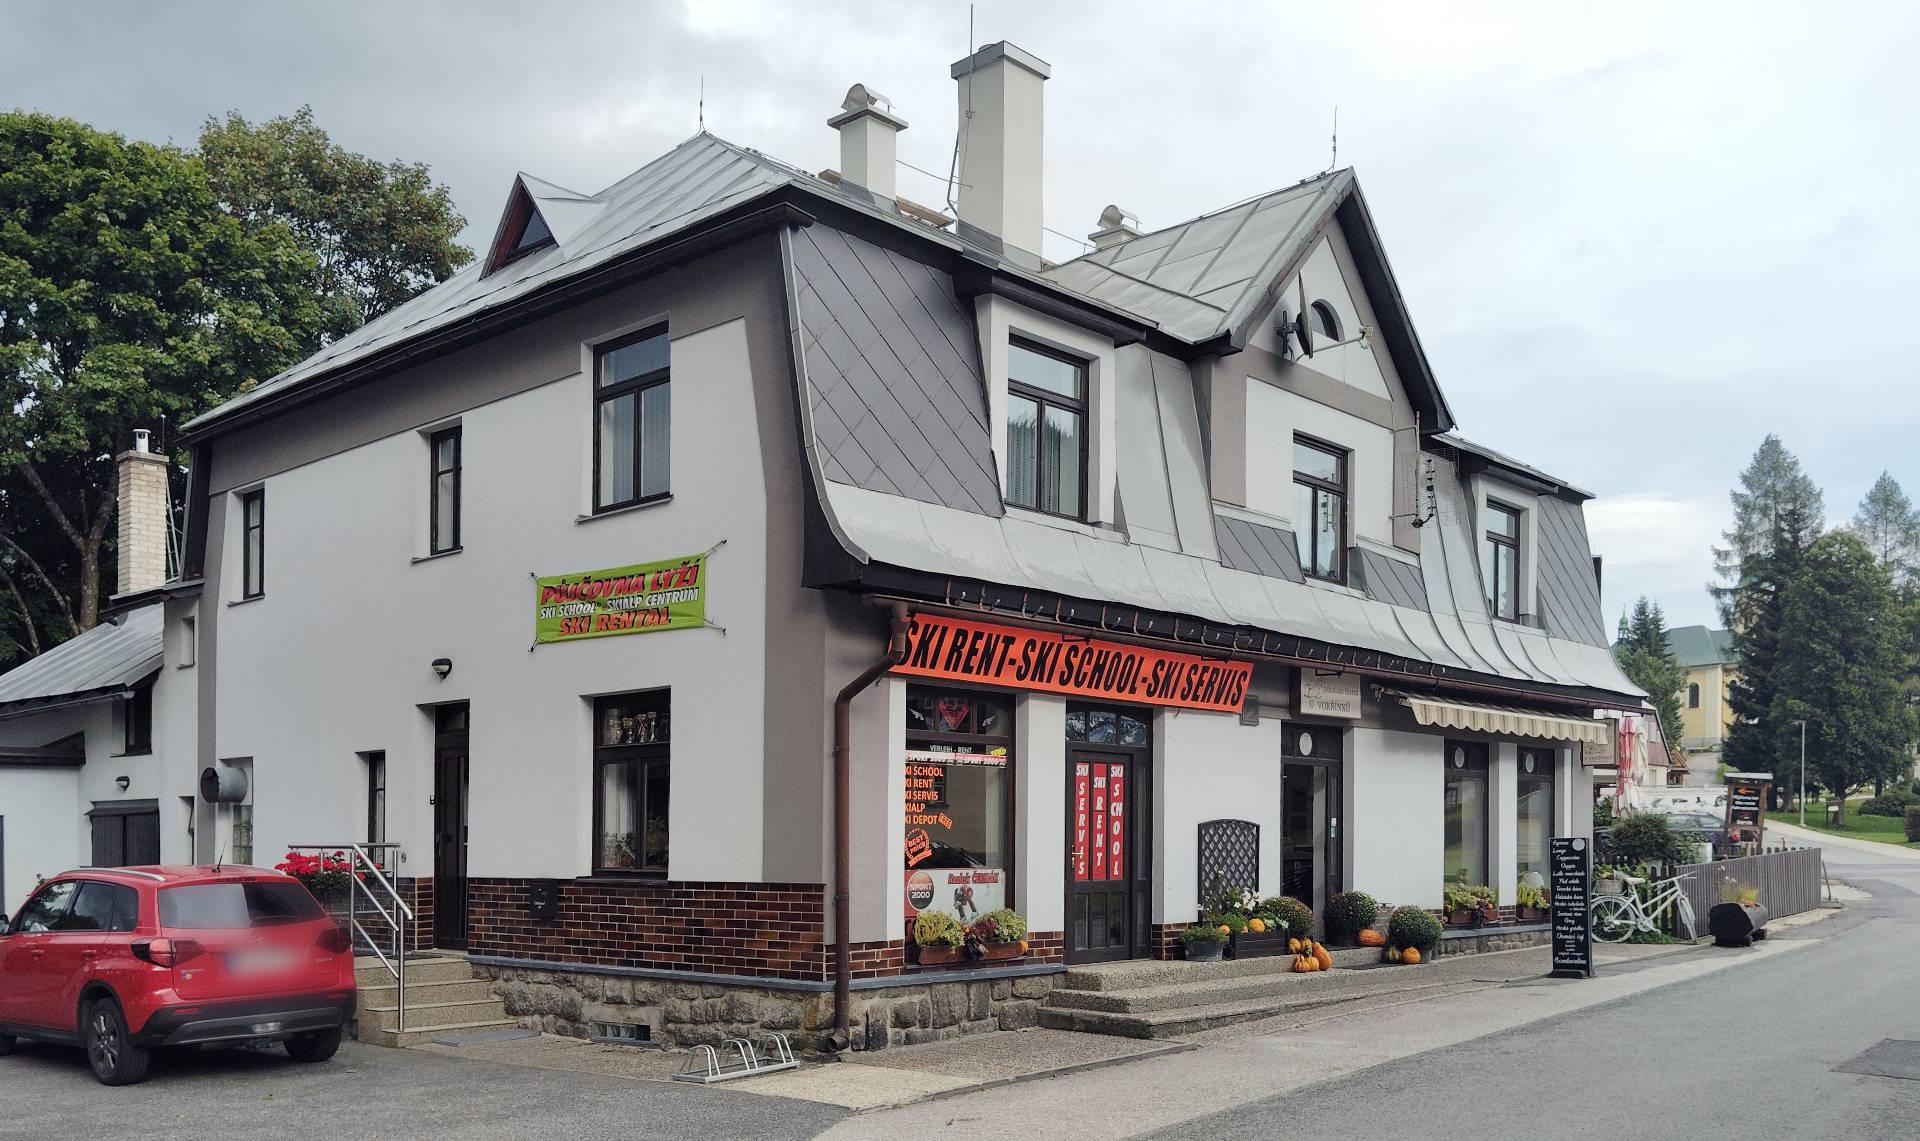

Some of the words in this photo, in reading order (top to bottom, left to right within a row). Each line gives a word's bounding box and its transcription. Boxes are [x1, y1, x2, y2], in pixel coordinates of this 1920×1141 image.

[541, 575, 646, 606] PŮJČOVNA
[650, 559, 701, 592] LYŽÍ
[540, 606, 557, 619] SKI
[559, 601, 596, 616] SCHOOL
[607, 595, 642, 612] SKIALP
[646, 588, 700, 607] CENTRUM
[560, 615, 591, 637] SKI
[596, 607, 673, 632] RENTAL
[896, 621, 947, 667] SKI
[1180, 662, 1248, 707] SERVIS
[914, 766, 943, 778] SCHOOL
[1076, 764, 1089, 776] SKI
[1110, 765, 1124, 777] SKI
[914, 778, 934, 789] RENT
[1093, 777, 1106, 789] SKI
[914, 790, 939, 801] SERVIS
[905, 803, 926, 813] KIALP
[914, 815, 938, 825] DEPOT
[909, 883, 932, 891] SPORT
[911, 891, 931, 899] 2000
